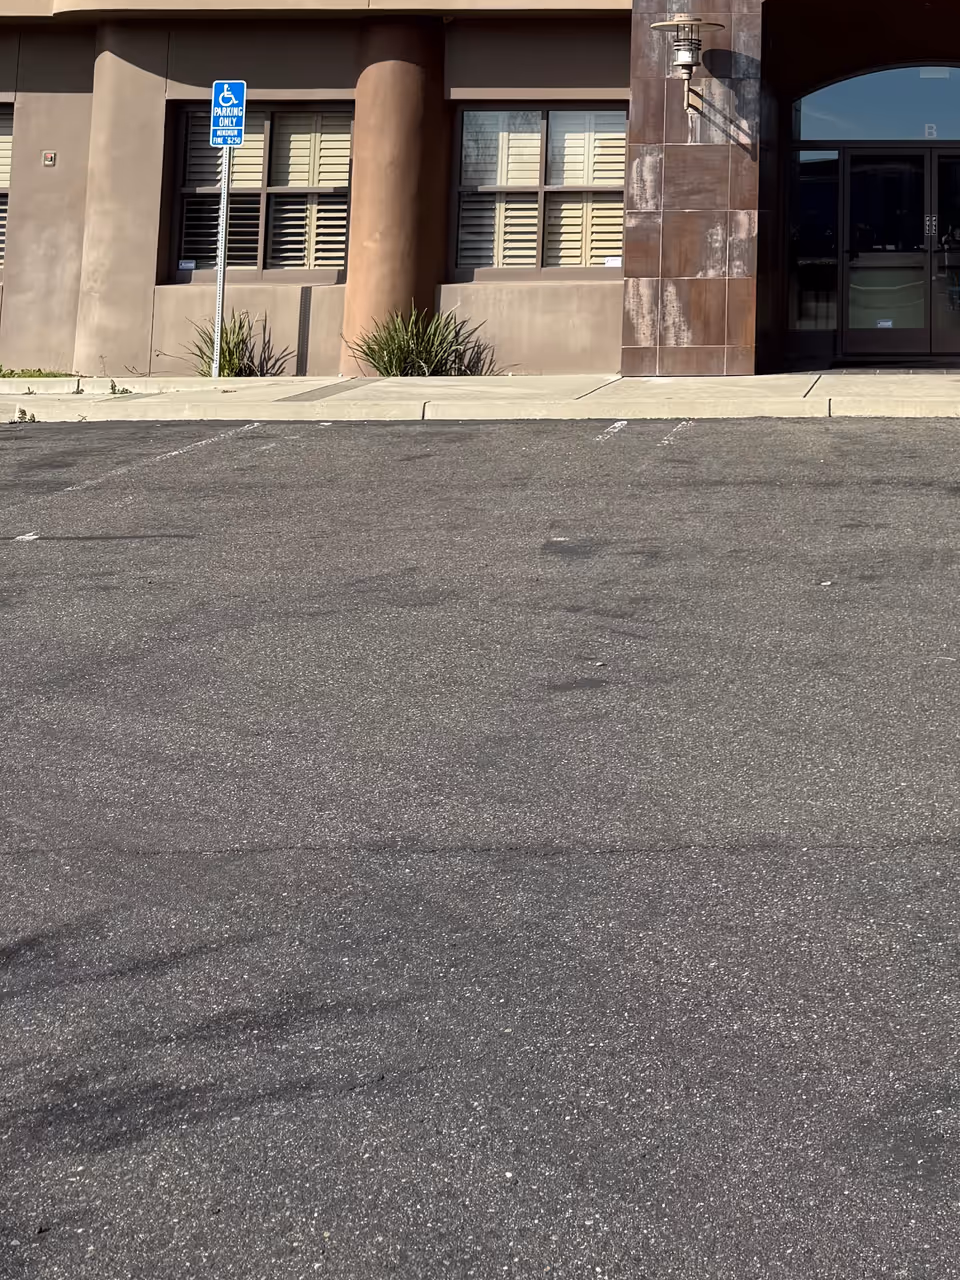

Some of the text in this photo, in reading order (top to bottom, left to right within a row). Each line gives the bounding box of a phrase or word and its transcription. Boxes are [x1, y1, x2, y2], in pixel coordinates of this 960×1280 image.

[214, 107, 243, 116] PARKING
[219, 117, 237, 126] ONLY
[924, 124, 937, 138] B
